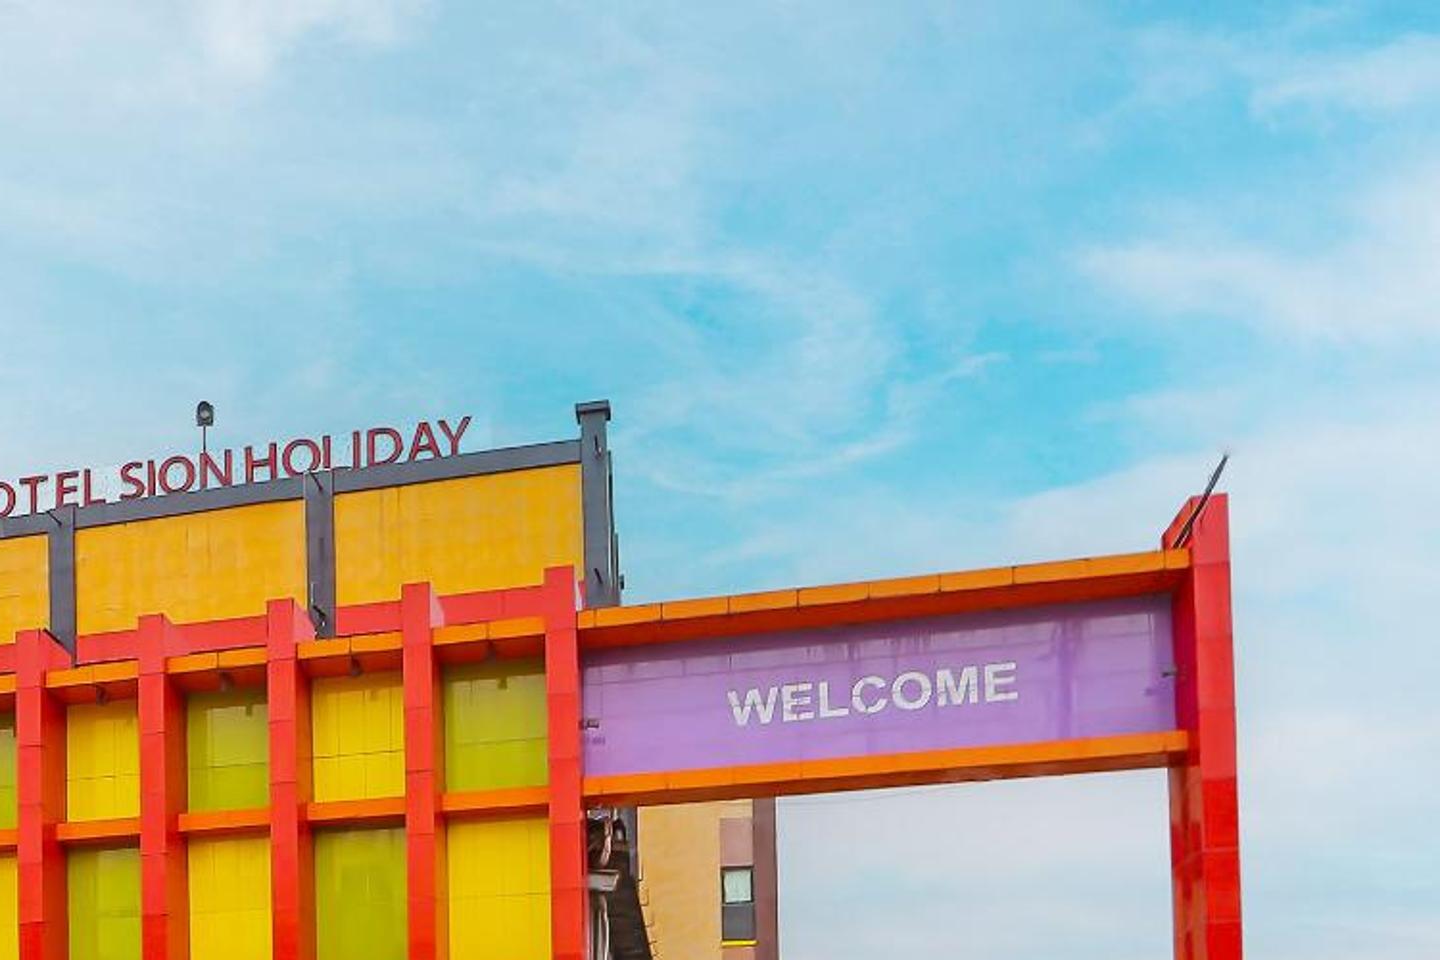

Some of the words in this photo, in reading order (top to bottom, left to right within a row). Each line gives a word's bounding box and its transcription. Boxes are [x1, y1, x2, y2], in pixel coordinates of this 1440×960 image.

[119, 449, 234, 499] SION
[244, 415, 472, 486] HOLIDAY
[727, 662, 1019, 727] WELCOME
